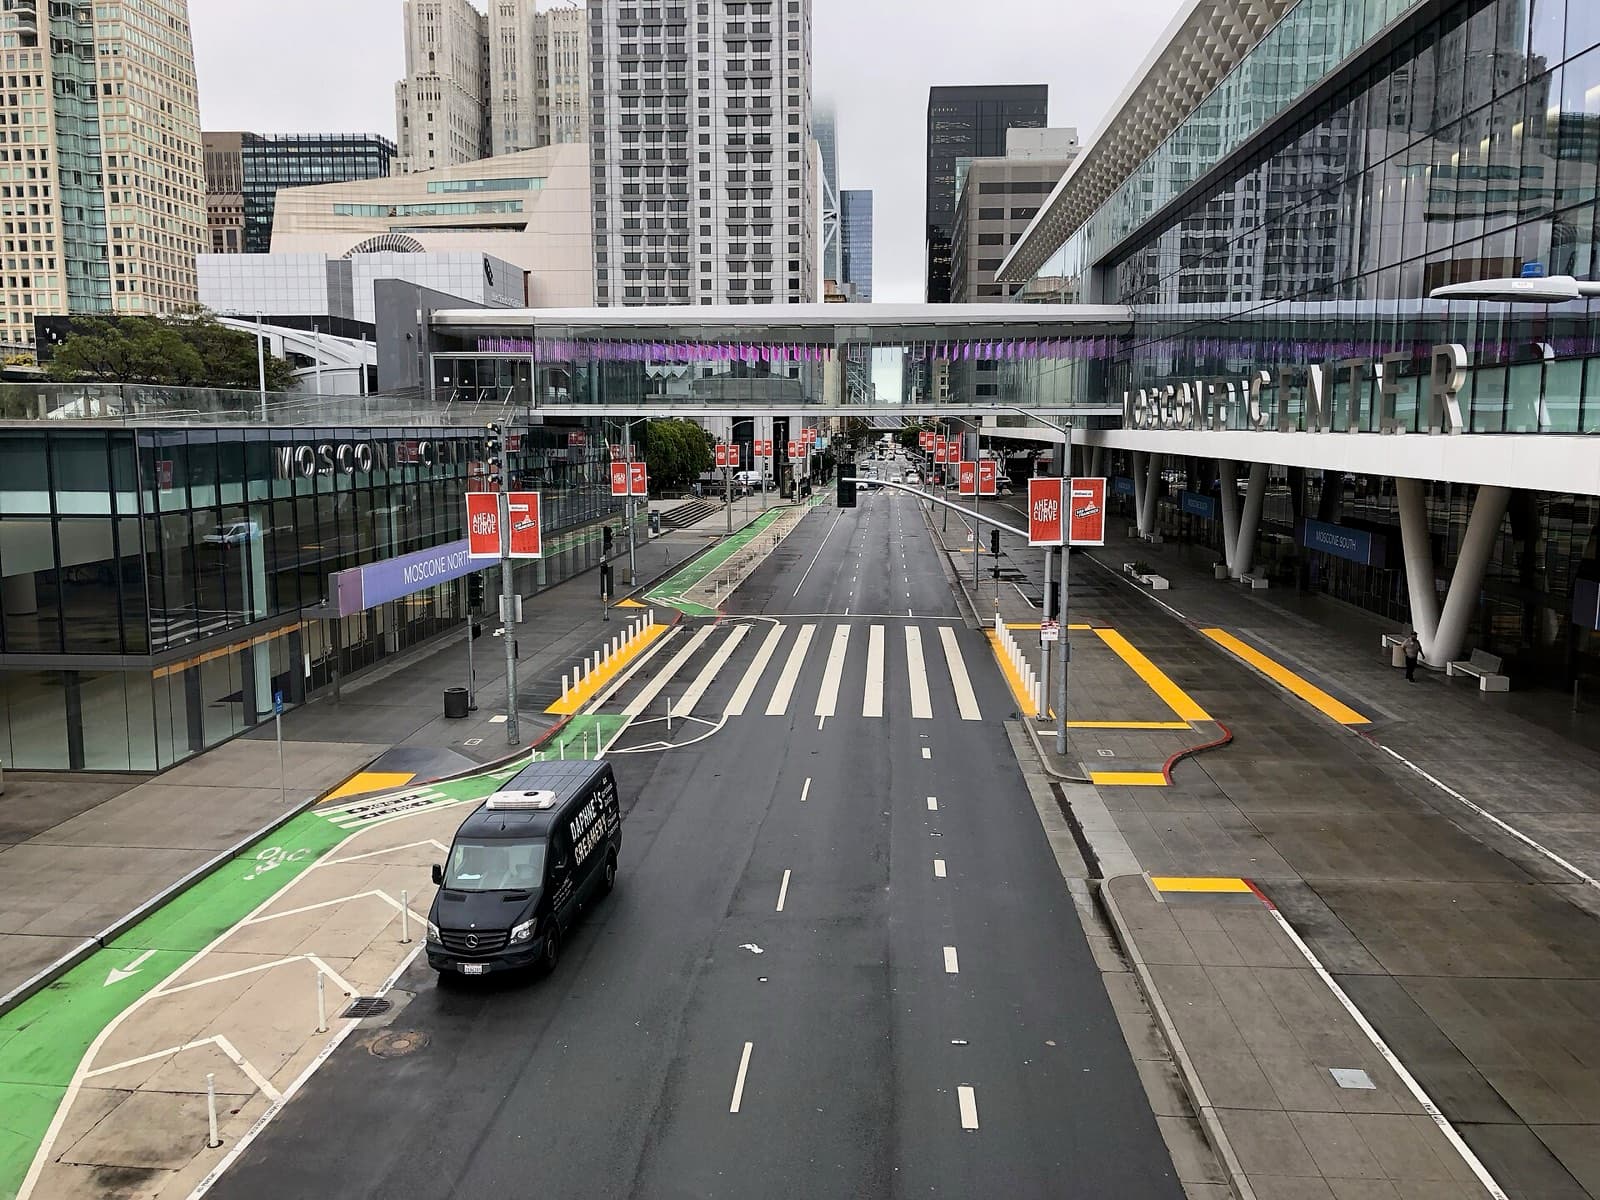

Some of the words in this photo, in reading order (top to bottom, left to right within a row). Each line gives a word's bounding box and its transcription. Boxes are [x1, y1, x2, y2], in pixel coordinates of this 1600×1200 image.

[1250, 343, 1468, 436] CENTER
[1033, 498, 1058, 512] AHEAD
[1033, 510, 1057, 522] CURVE
[472, 512, 496, 524] AHEAD
[472, 523, 496, 535] CURVE
[404, 556, 446, 584] MOSCONE
[447, 550, 472, 571] NORTH
[570, 792, 603, 843] DAPHNE'S
[575, 813, 607, 866] CREAMERY
